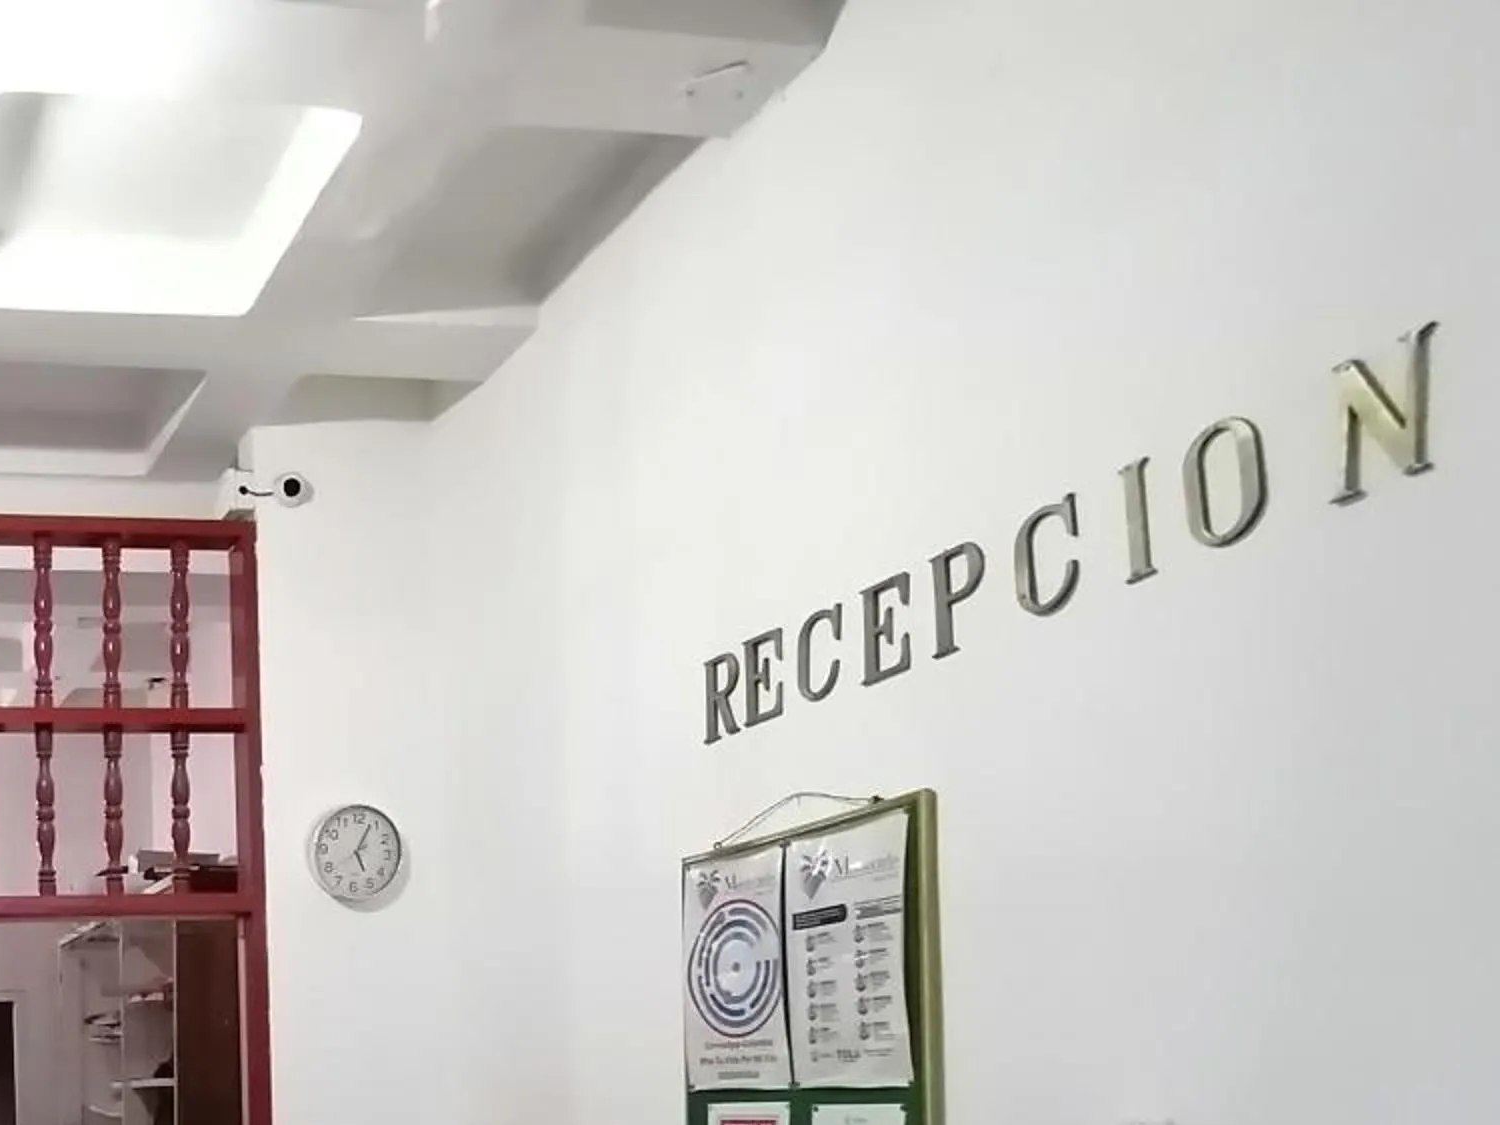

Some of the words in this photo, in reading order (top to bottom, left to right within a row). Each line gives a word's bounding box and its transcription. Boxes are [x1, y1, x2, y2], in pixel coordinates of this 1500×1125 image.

[703, 320, 1440, 745] RECEPCION
[352, 812, 367, 824] 12
[324, 861, 334, 873] 8
[333, 875, 344, 886] 7
[365, 877, 376, 889] 5
[349, 881, 359, 893] 6
